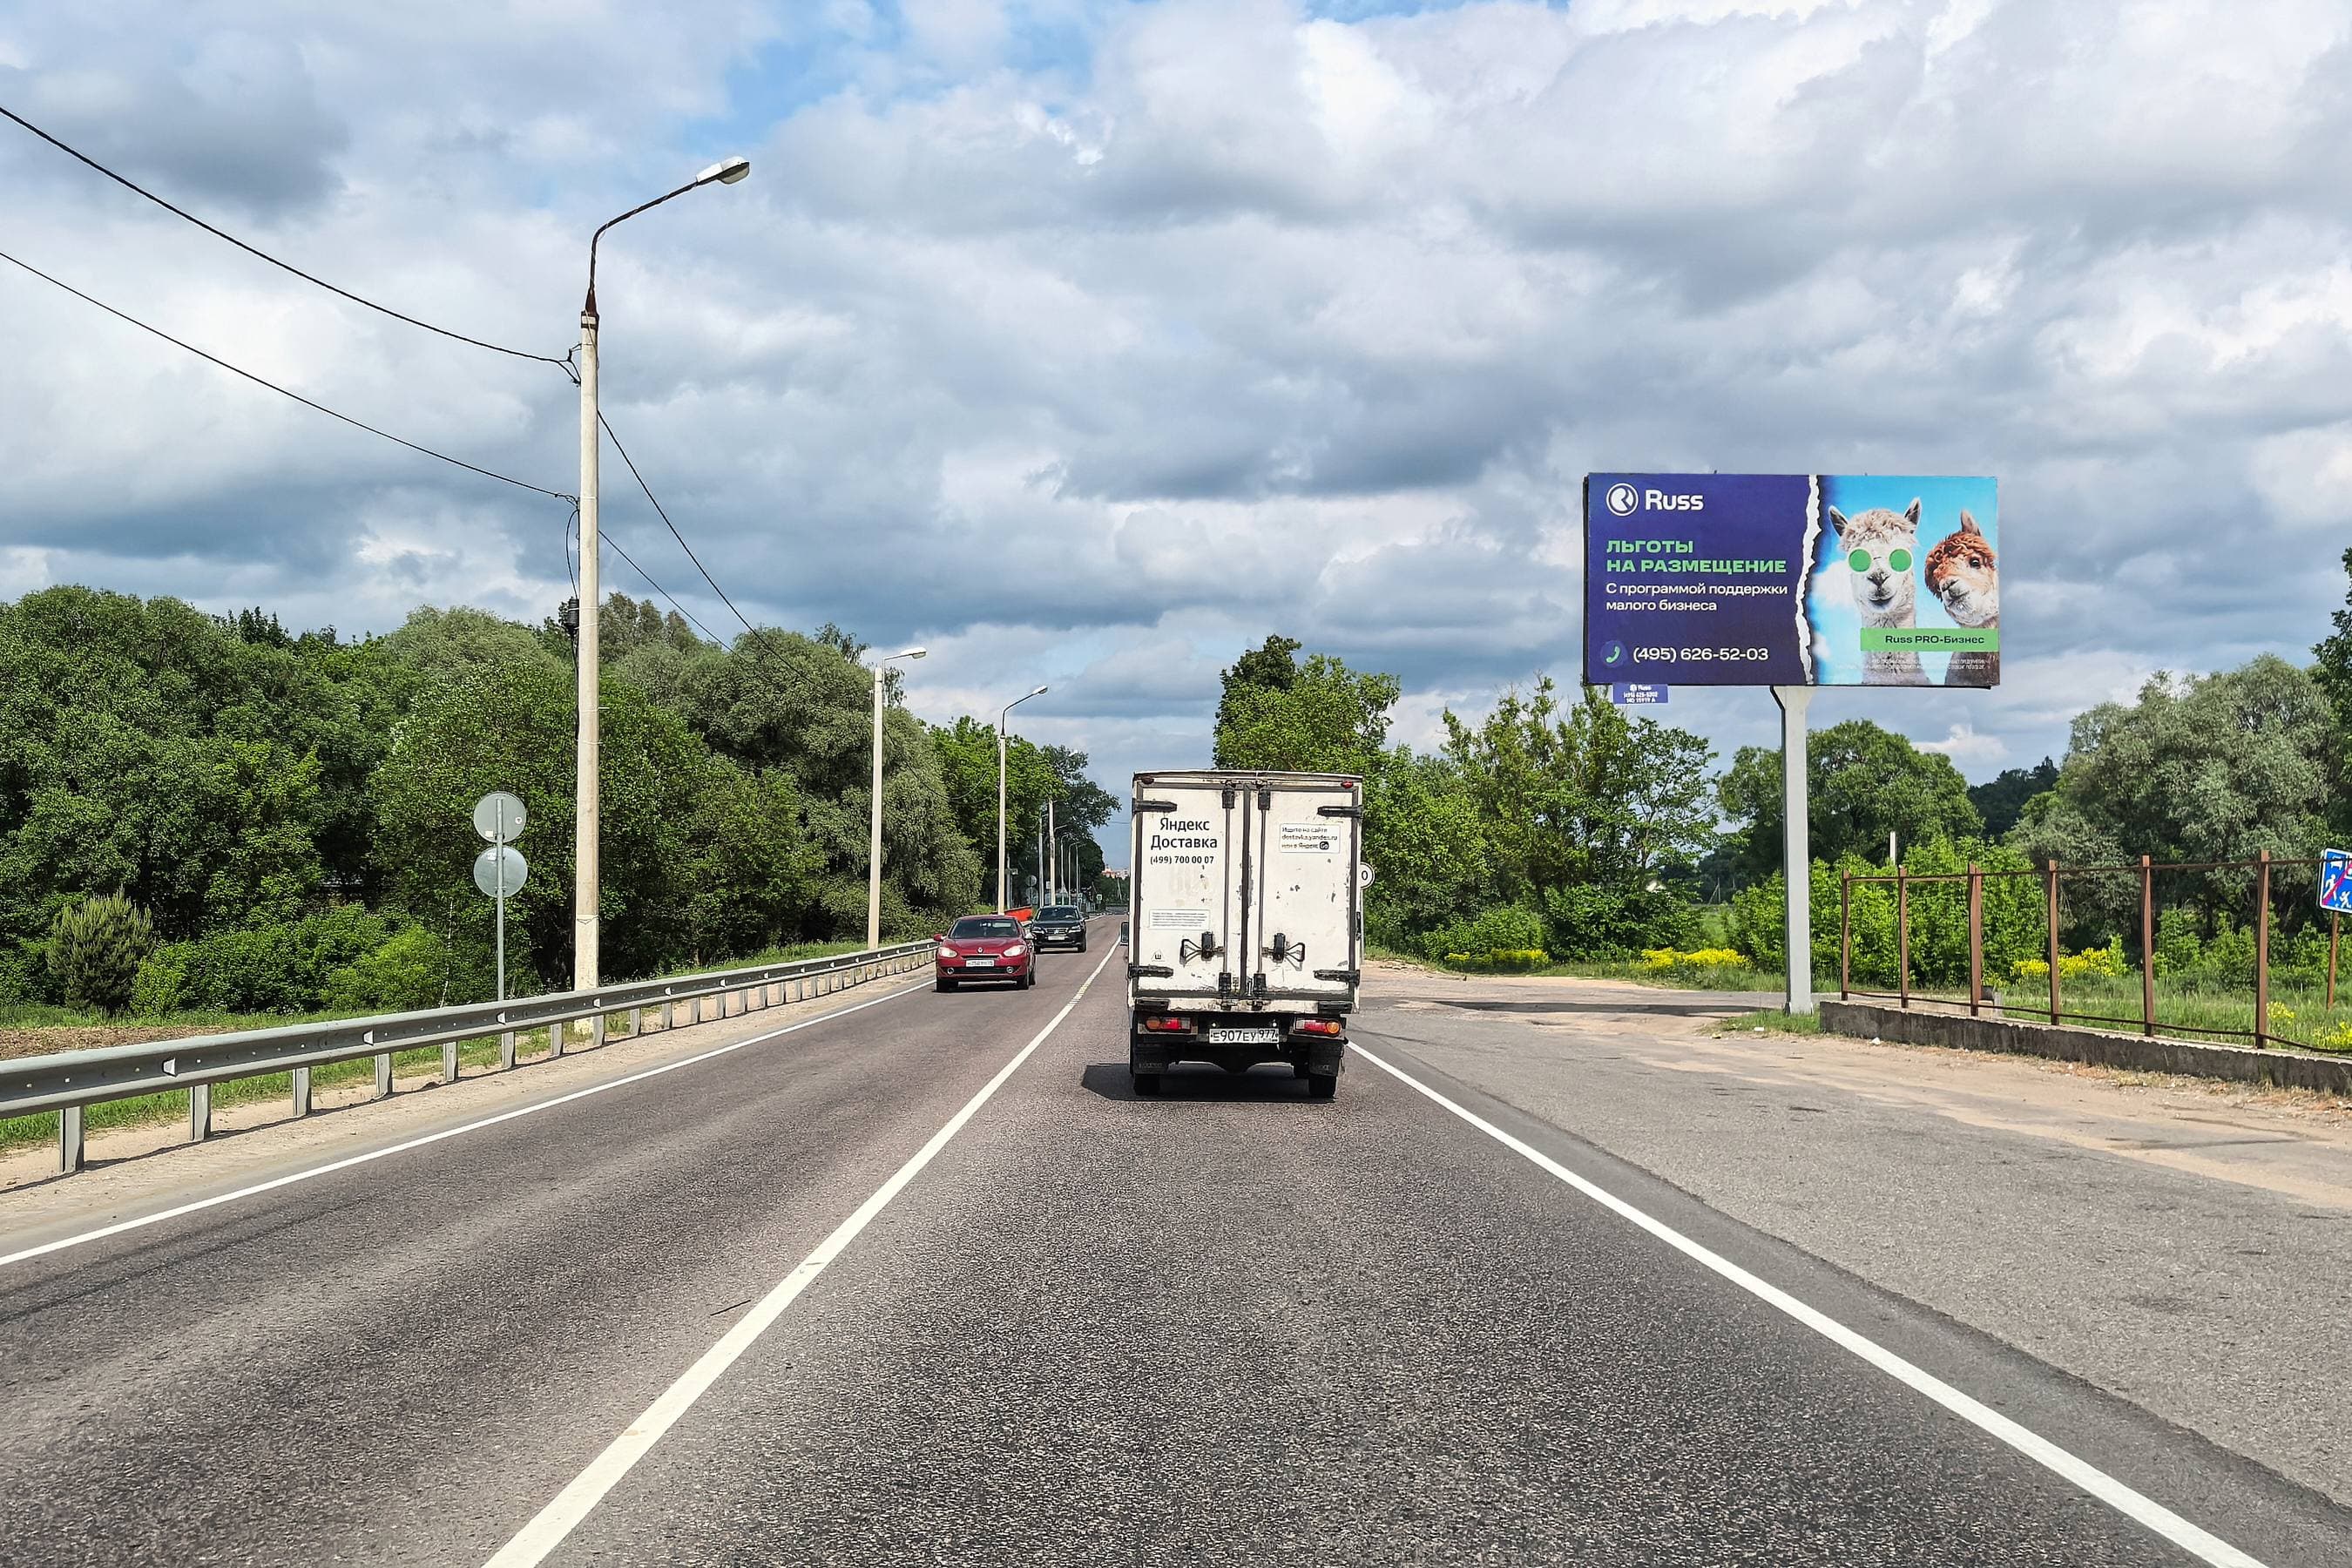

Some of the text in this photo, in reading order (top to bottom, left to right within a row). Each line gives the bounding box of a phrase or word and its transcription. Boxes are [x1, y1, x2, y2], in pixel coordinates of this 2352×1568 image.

[1645, 490, 1704, 510] Russ
[1606, 540, 1693, 553] ЛЬГОТЫ
[1606, 559, 1786, 575] НА РАЗМЕЩЕНИЕ
[1605, 583, 1788, 597] С программой поддержки
[1605, 599, 1717, 612] малого бизнеса
[1885, 635, 1985, 645] Russ PRO-Бизнес
[1632, 647, 1769, 663] (495) 626-52-03
[1160, 817, 1210, 832] Яндекс
[1151, 835, 1218, 850] Доставка
[1150, 855, 1214, 865] (499) 700 00 07
